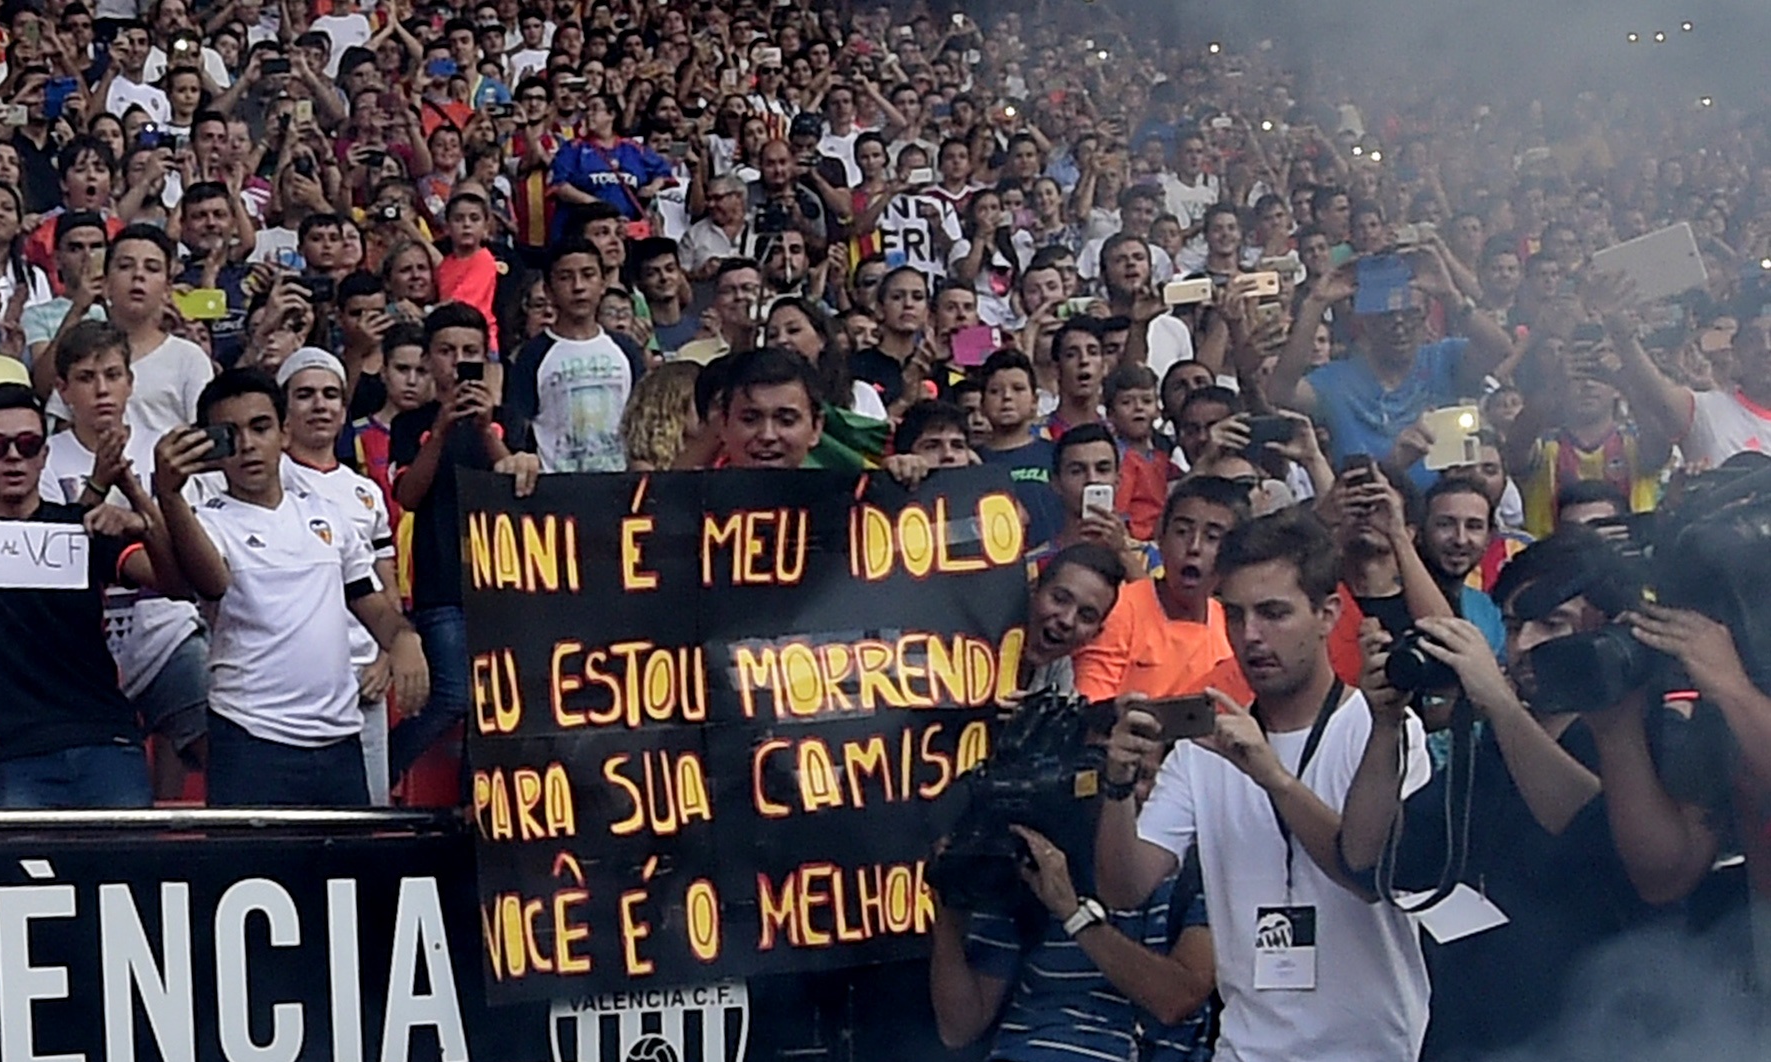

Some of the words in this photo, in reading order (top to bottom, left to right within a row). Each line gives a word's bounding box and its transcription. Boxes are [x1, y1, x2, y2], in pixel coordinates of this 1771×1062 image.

[467, 511, 582, 592] NANI
[621, 475, 657, 592] É
[702, 509, 809, 586] MEU
[849, 475, 1024, 579] ÍDOLO
[472, 648, 522, 736] EU
[550, 640, 707, 728] ESTOU
[473, 764, 575, 841] PARA
[603, 750, 711, 835] SUA
[483, 851, 592, 981] VOCÊ
[621, 856, 658, 975] É
[684, 877, 722, 963] O
[569, 989, 686, 1013] VALENCIA
